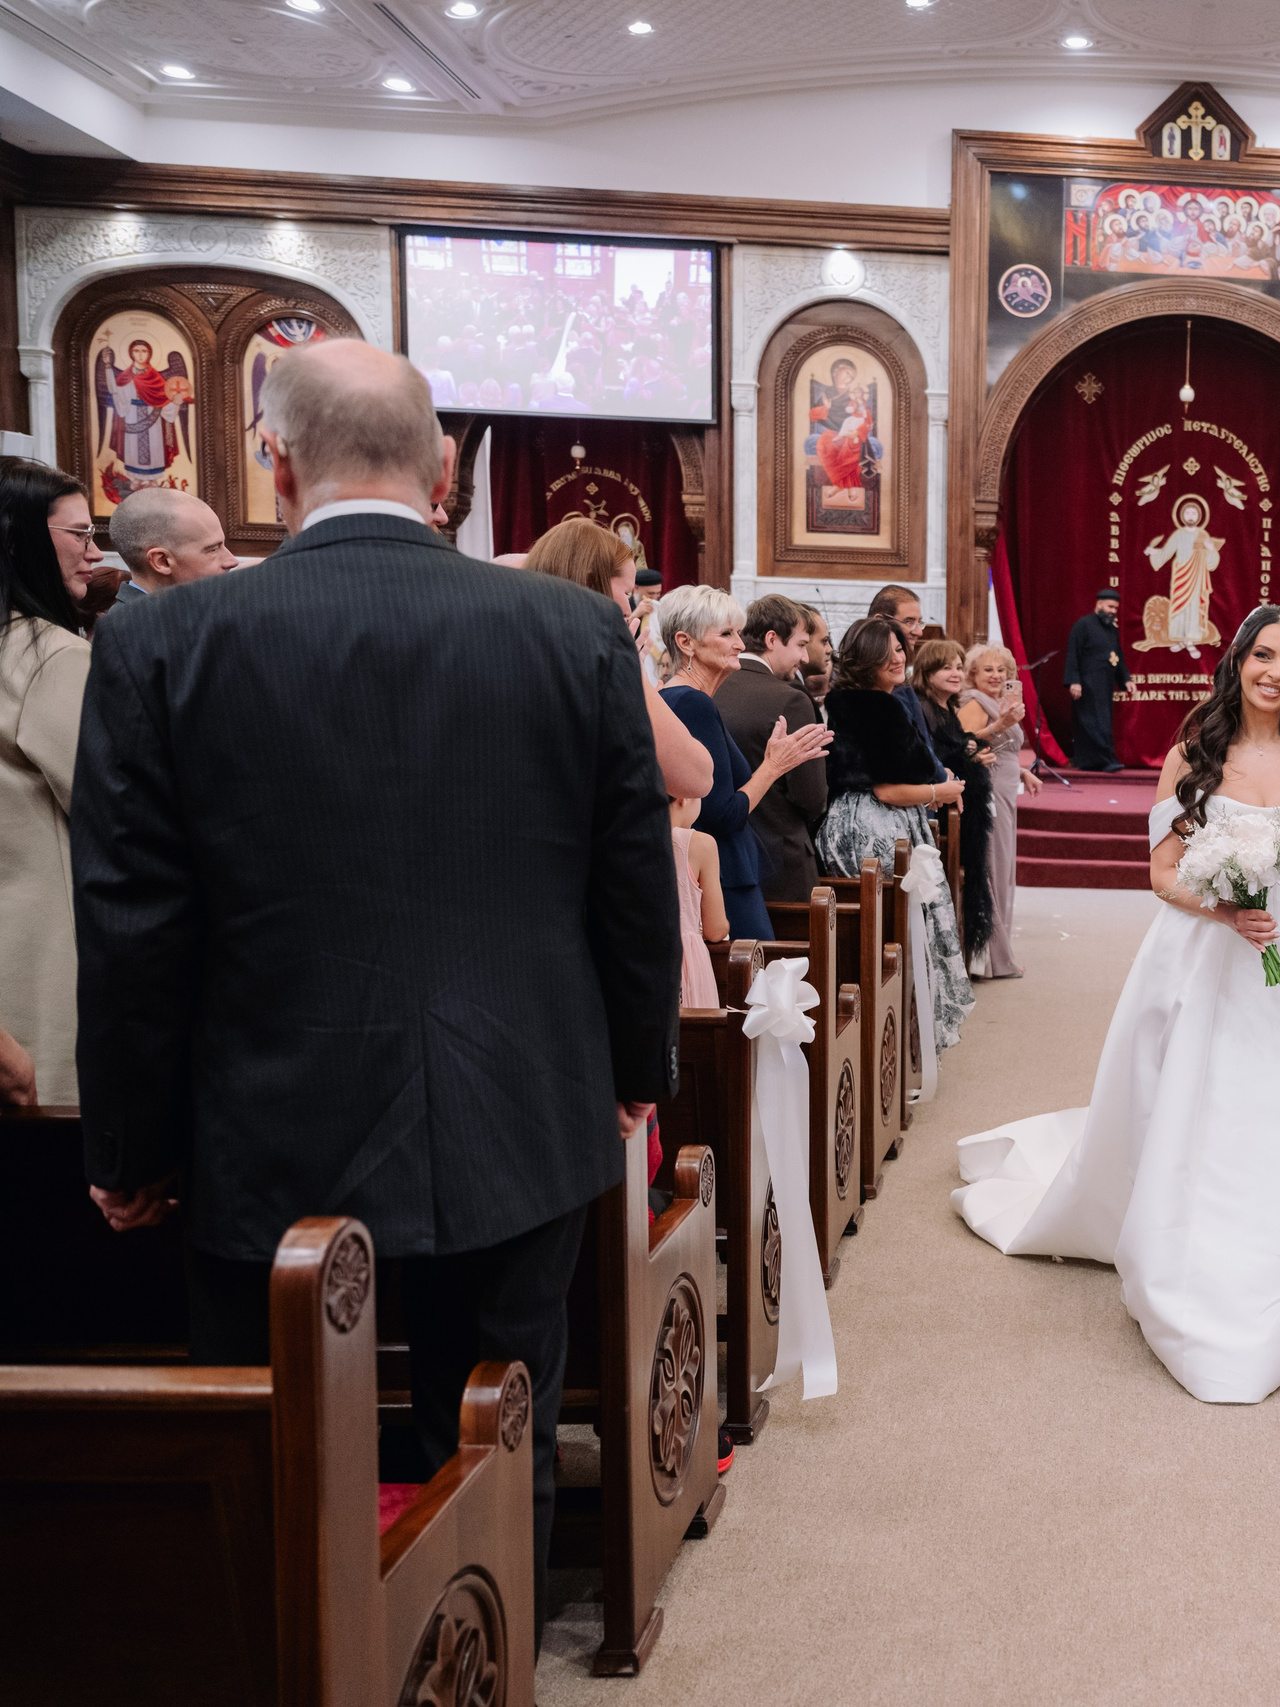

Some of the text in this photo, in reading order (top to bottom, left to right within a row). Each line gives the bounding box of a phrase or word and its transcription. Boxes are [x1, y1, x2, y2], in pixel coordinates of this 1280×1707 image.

[1130, 673, 1146, 684] HE
[1147, 673, 1209, 684] BEHOLDER
[1131, 690, 1167, 701] MARK
